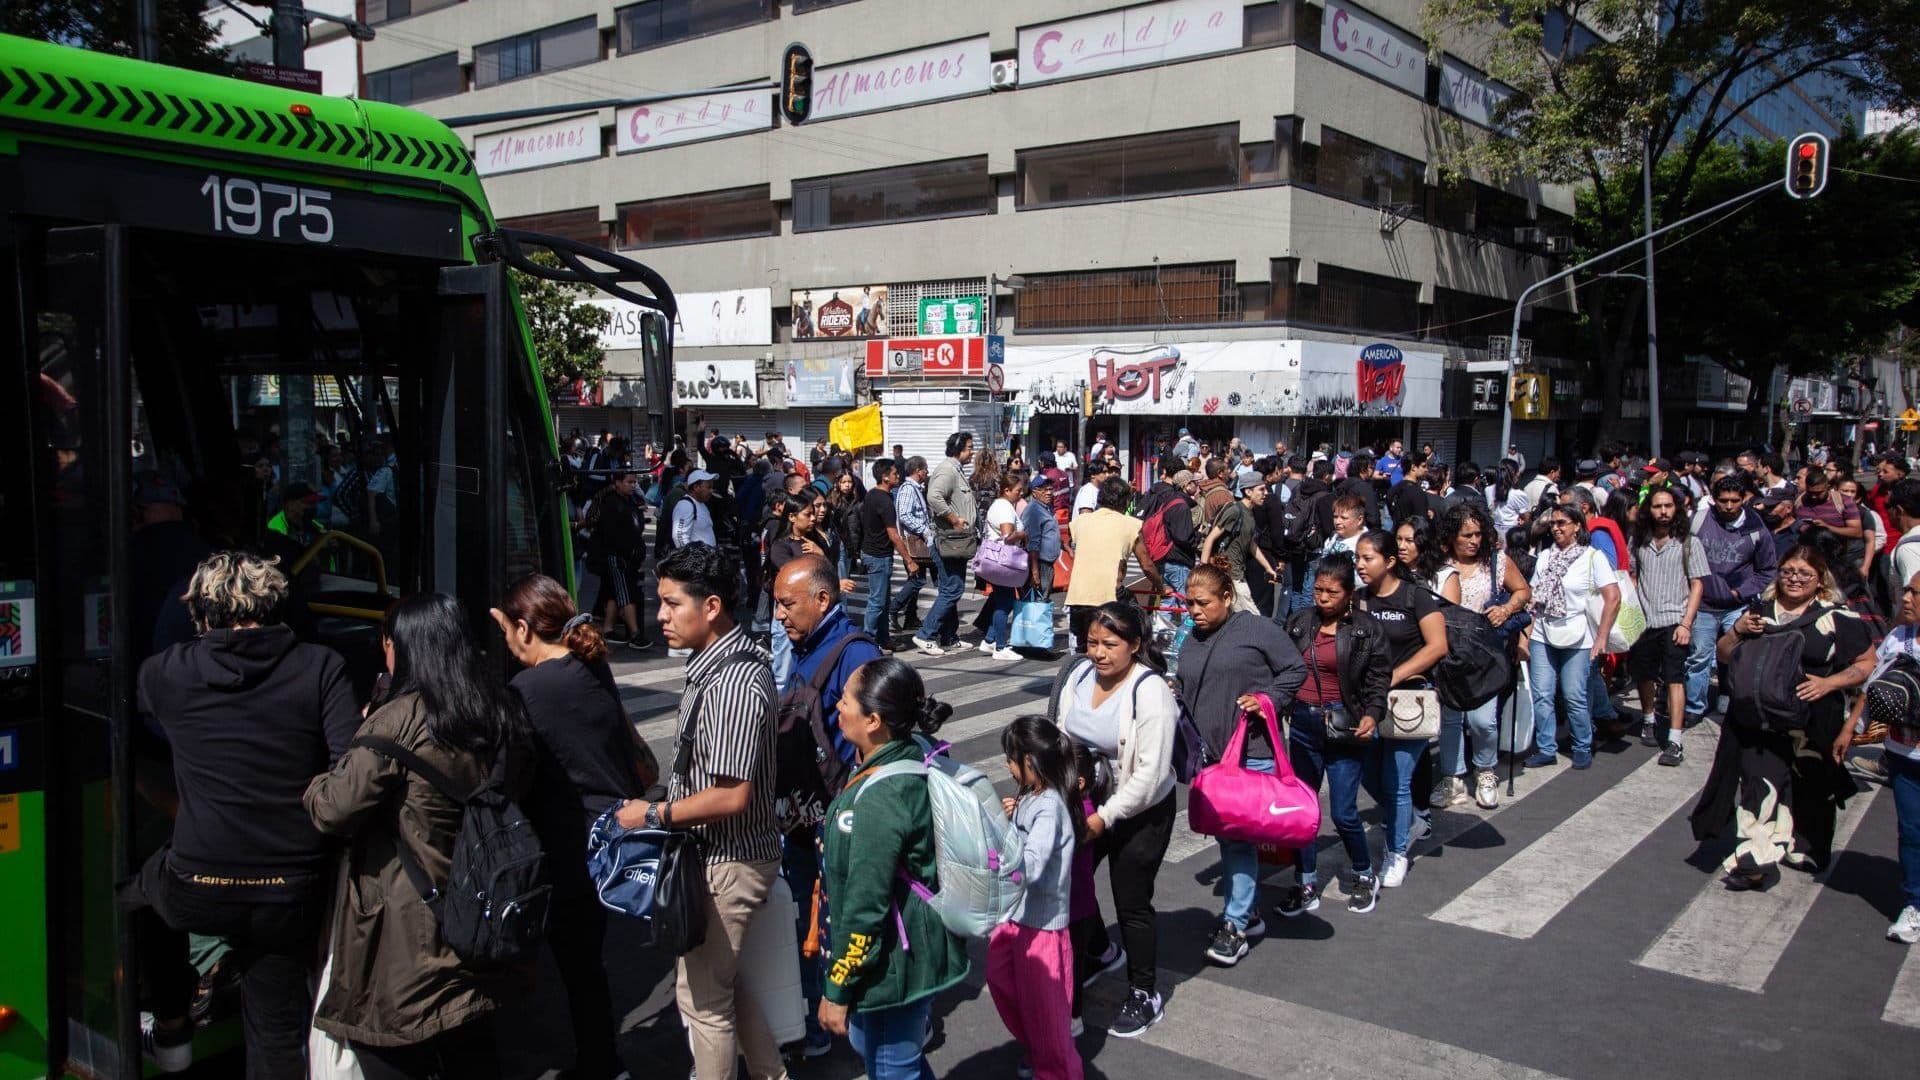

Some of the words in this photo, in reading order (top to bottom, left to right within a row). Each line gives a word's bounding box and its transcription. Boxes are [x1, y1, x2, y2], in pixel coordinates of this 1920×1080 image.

[1032, 9, 1225, 74] Candya
[1332, 8, 1416, 71] Candya
[815, 53, 967, 111] Almacenes
[629, 97, 758, 145] Candya
[488, 127, 585, 168] Almacenes
[201, 175, 334, 243] 1975
[820, 314, 851, 328] RIDERS
[1364, 348, 1399, 361] AMERICAN
[676, 380, 709, 400] BAO
[720, 379, 754, 400] TEA
[1088, 357, 1178, 401] HOT
[1381, 610, 1405, 621] Klein
